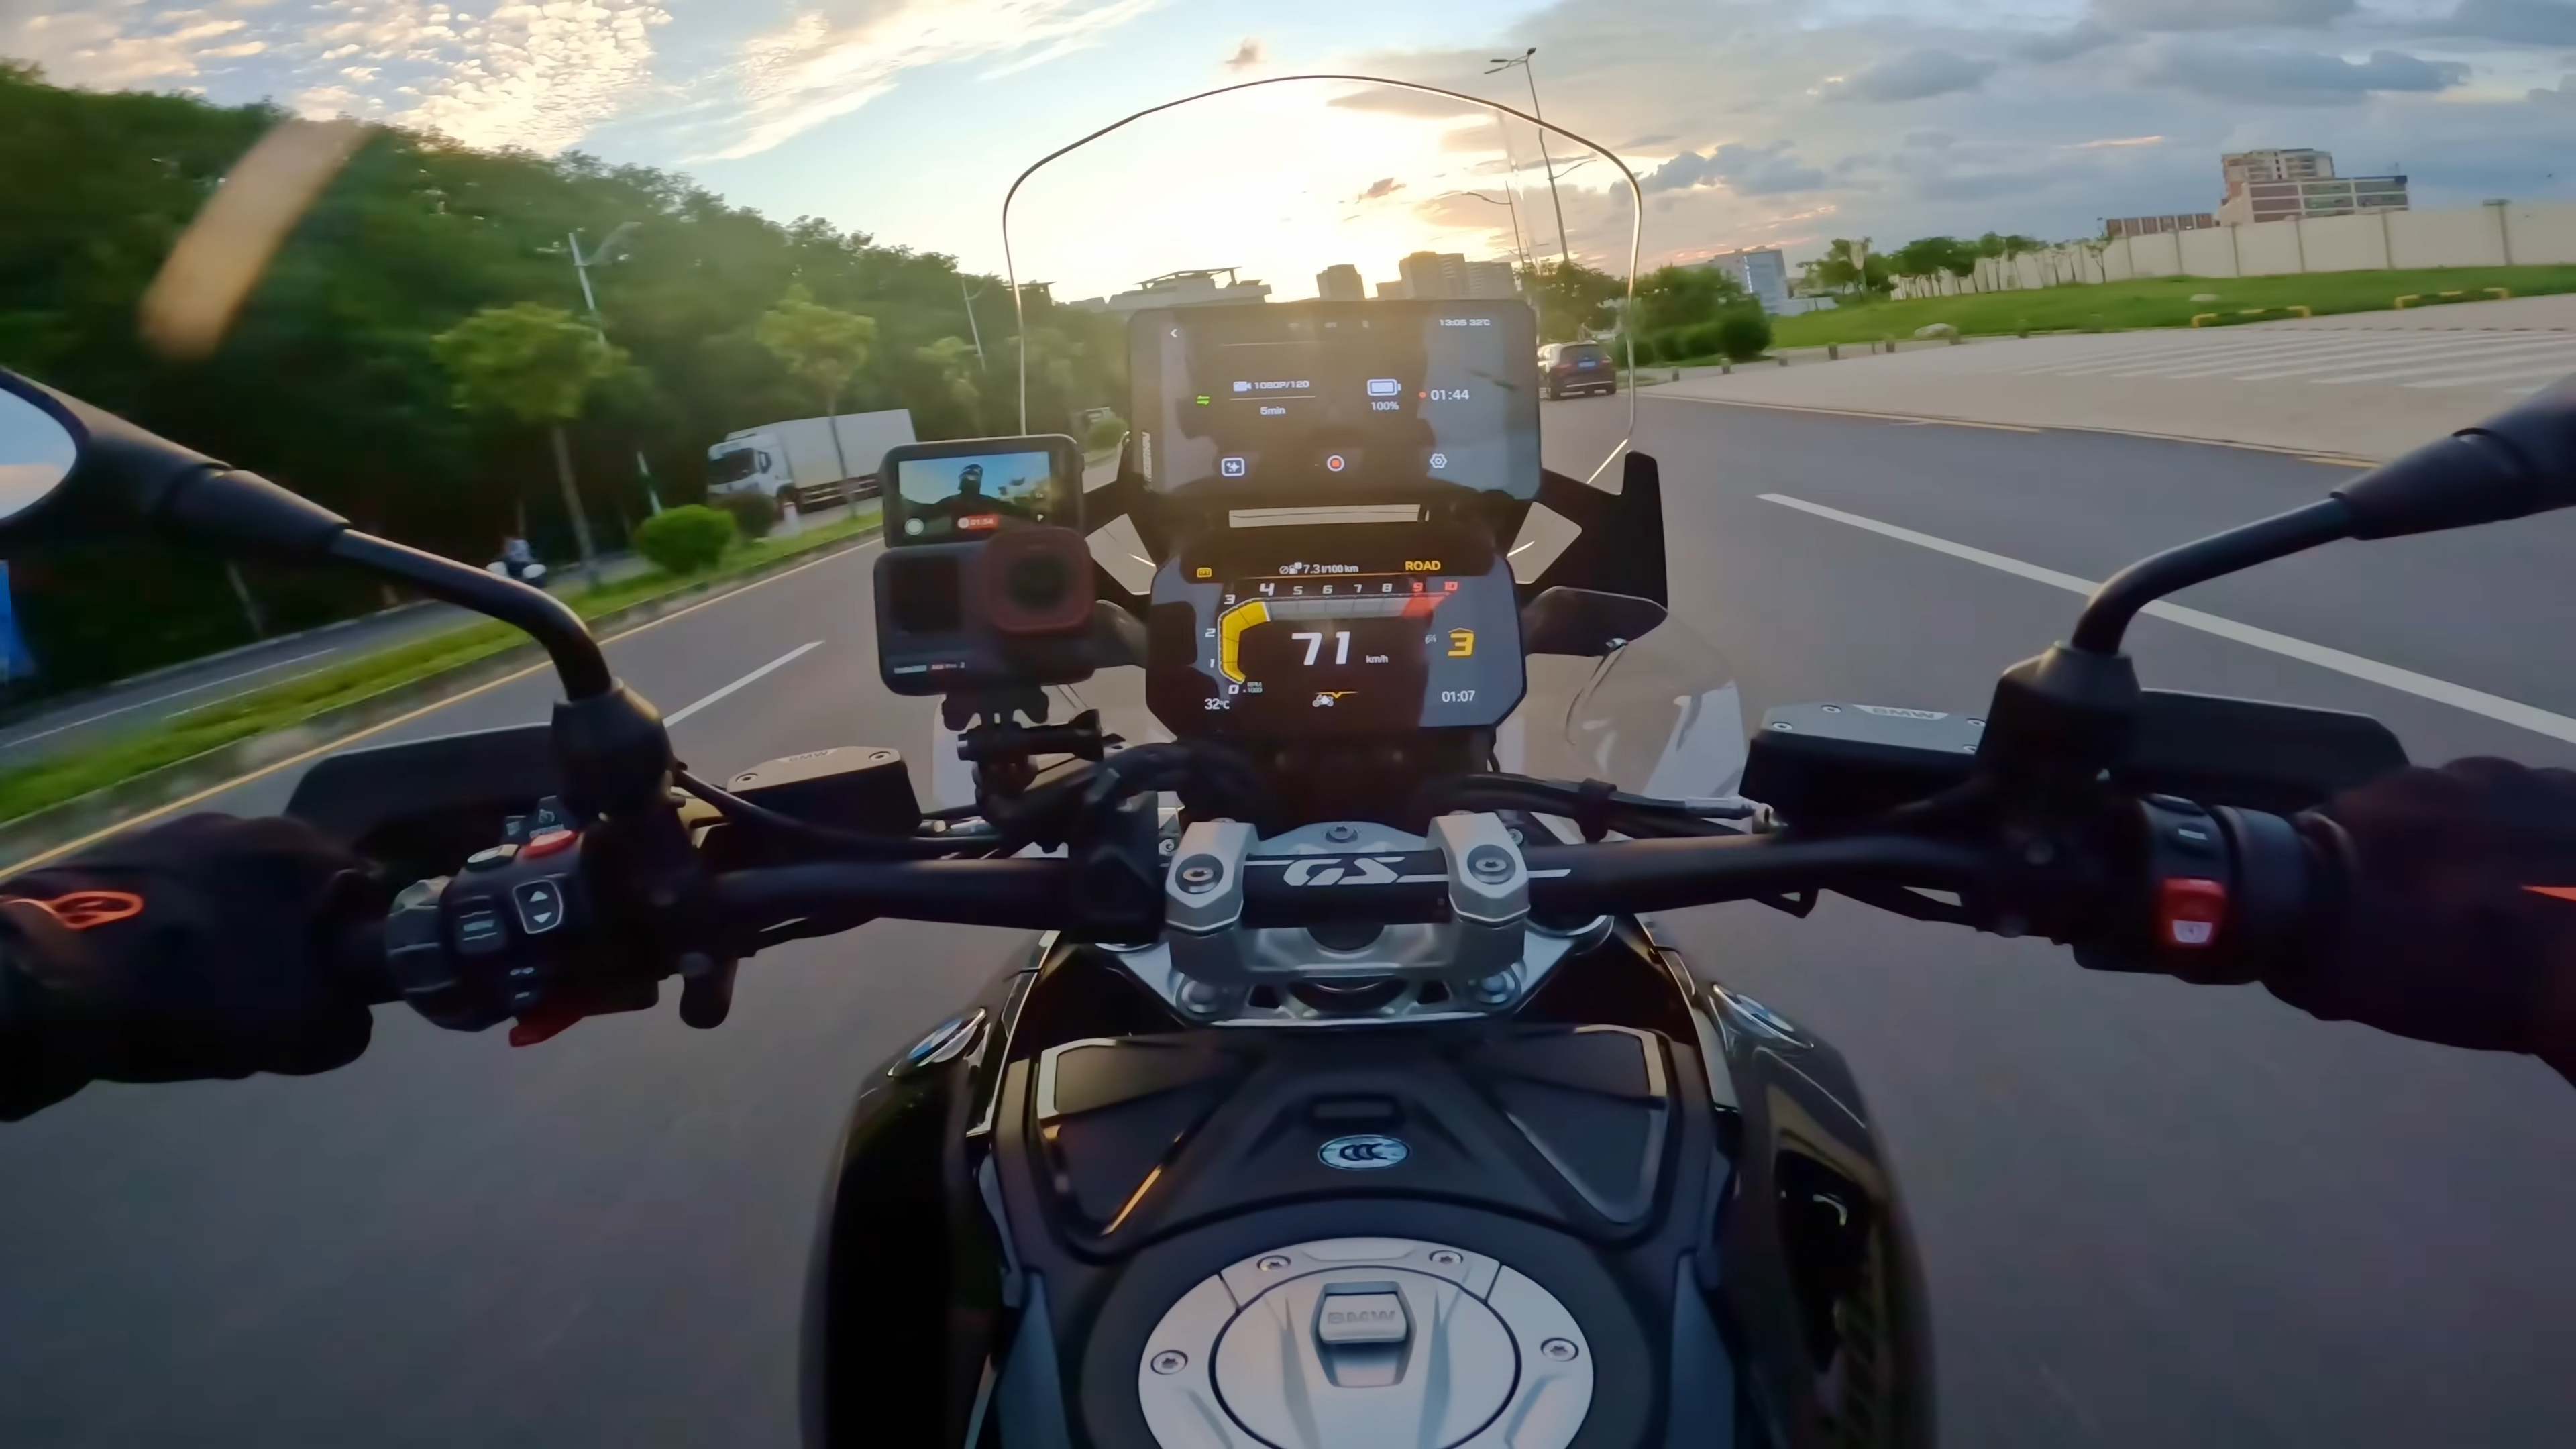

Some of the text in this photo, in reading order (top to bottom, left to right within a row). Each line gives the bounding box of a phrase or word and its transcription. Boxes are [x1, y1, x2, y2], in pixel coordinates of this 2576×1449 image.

[1254, 380, 1310, 390] 1080P/120
[1430, 389, 1470, 400] 01:44
[1260, 406, 1286, 415] 5min
[1371, 401, 1399, 411] 100%
[1303, 564, 1320, 574] 7.3
[1344, 564, 1360, 573] km
[1405, 560, 1441, 571] ROAD
[1259, 581, 1458, 596] 4 5 6 7 8 9 10
[1223, 594, 1236, 604] 3
[1205, 627, 1216, 637] 2
[1291, 631, 1350, 665] 71
[1447, 633, 1474, 657] 3
[1210, 659, 1215, 668] 1
[1366, 655, 1389, 663] km/h
[1228, 684, 1240, 694] 0
[1442, 690, 1476, 702] 01:07
[1872, 707, 1935, 719] BMW
[789, 751, 828, 762] BMW
[1283, 857, 1405, 886] GS
[1327, 1310, 1396, 1324] BMW
